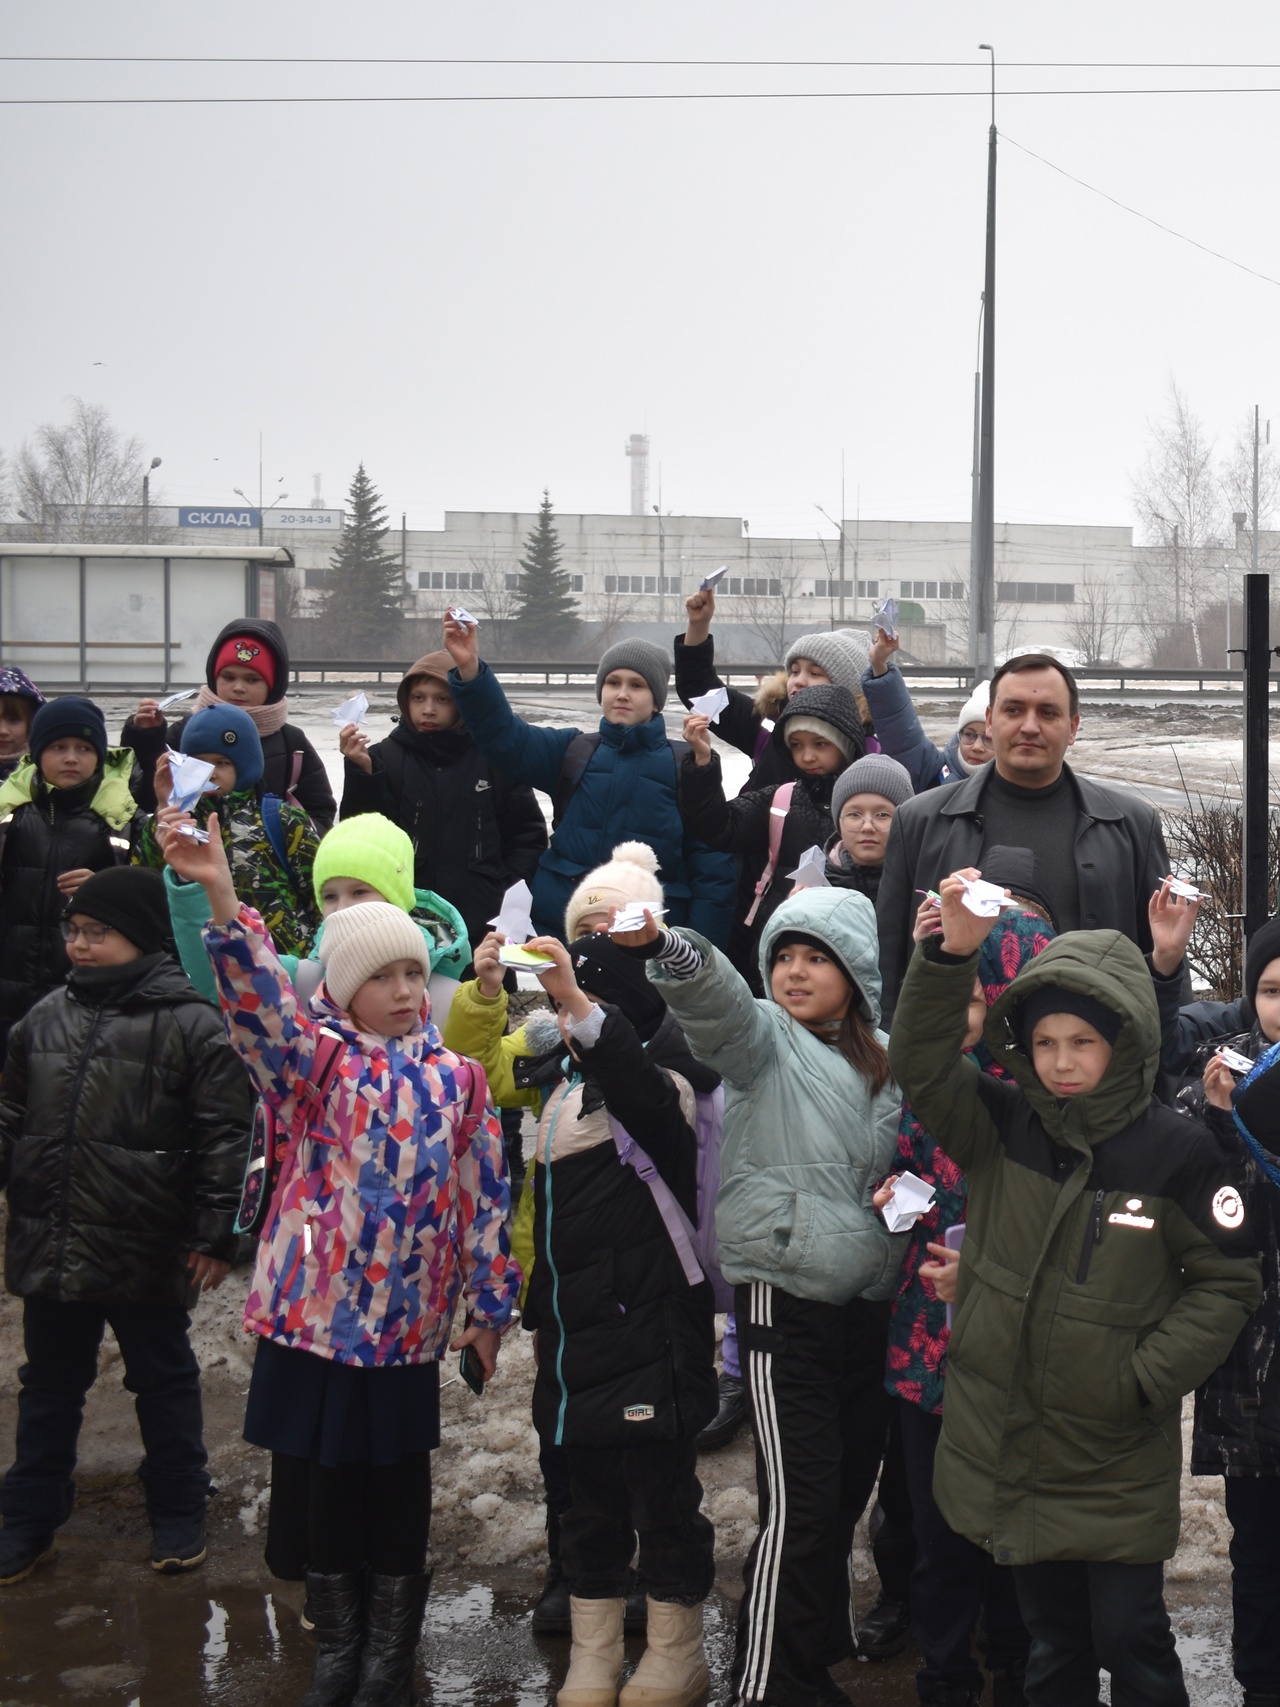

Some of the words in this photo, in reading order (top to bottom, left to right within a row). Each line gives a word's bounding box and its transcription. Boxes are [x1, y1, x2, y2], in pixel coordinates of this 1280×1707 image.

[187, 512, 251, 526] СКЛАД
[280, 515, 332, 524] 20-34-34
[627, 1409, 652, 1417] GIRL
